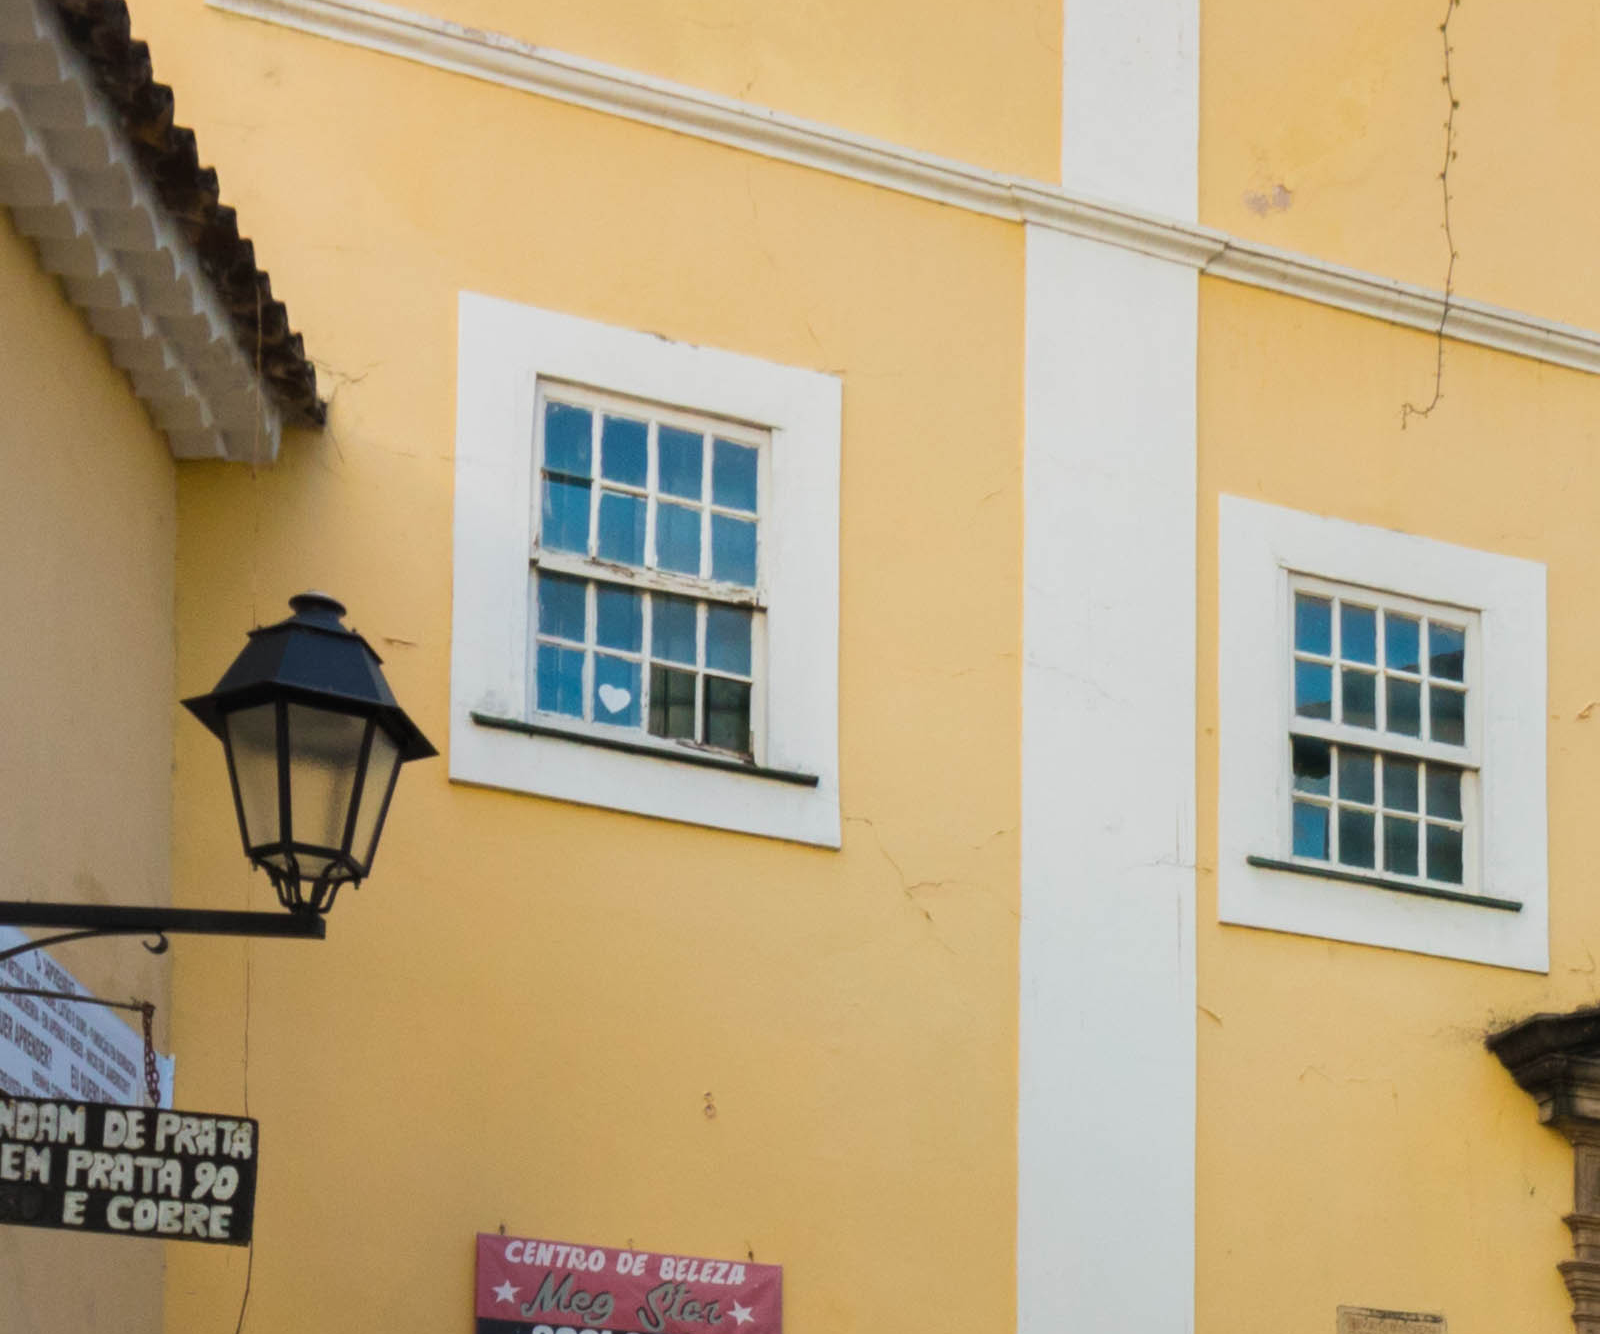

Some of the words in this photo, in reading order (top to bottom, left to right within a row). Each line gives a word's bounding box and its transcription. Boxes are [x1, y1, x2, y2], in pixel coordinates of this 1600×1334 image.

[103, 1109, 147, 1150] DE
[155, 1113, 253, 1160] PRATA
[0, 1143, 51, 1184] EM
[66, 1149, 182, 1198] PRATA
[191, 1162, 239, 1201] 90
[62, 1191, 88, 1225] E
[107, 1196, 233, 1238] COBRE
[505, 1240, 606, 1272] CENTRO
[616, 1252, 648, 1276] DE
[659, 1257, 746, 1286] BELEZA
[520, 1270, 615, 1326] Meg
[636, 1281, 723, 1333] Star
